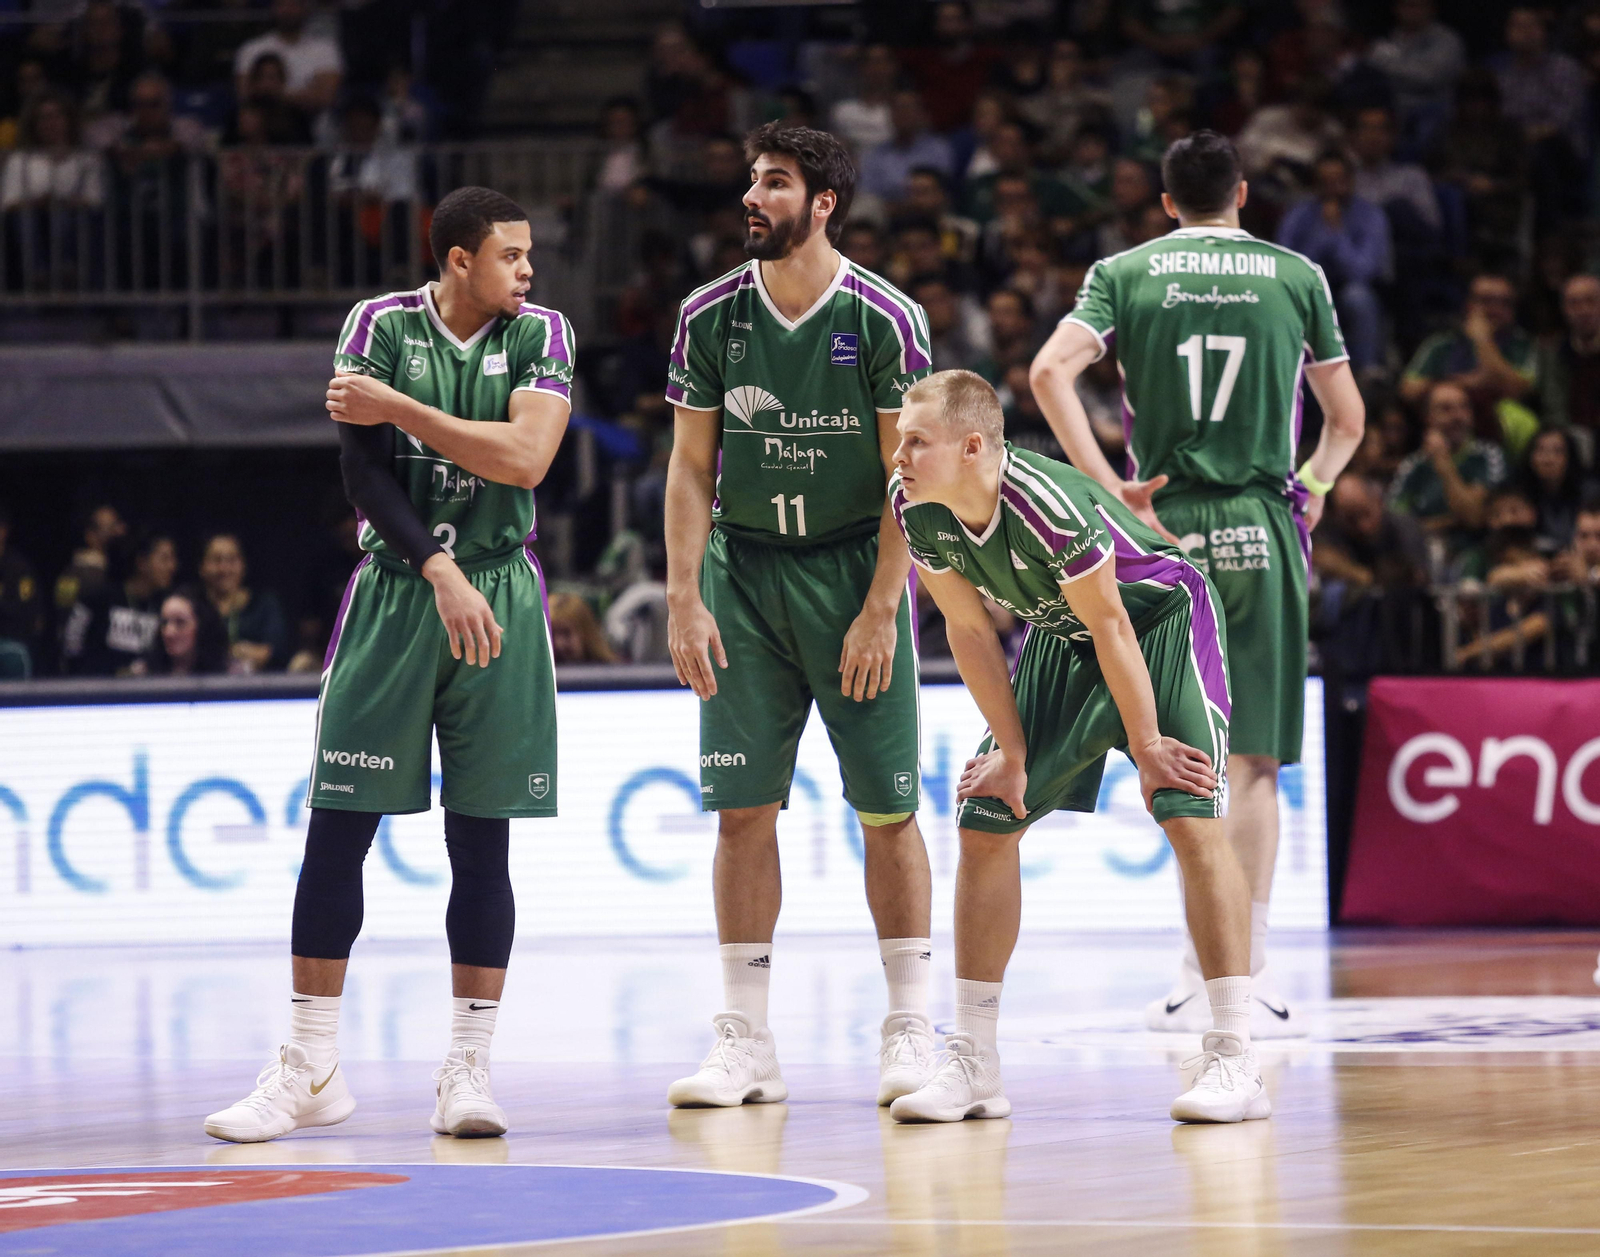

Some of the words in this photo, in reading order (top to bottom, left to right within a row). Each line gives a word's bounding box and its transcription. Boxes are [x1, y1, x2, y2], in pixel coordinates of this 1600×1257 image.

[1148, 251, 1276, 278] SHERMADINI
[1176, 335, 1247, 422] 17
[780, 408, 861, 430] Unicaja
[764, 437, 828, 475] Málaga
[432, 464, 486, 500] Málaga
[771, 493, 807, 536] 11
[1209, 526, 1269, 546] COSTA
[1211, 545, 1241, 559] DEL
[1241, 543, 1270, 558] SOL
[322, 749, 394, 770] worten
[700, 751, 746, 768] orten
[320, 782, 354, 794] SPALDING
[974, 805, 1011, 822] SPALDING
